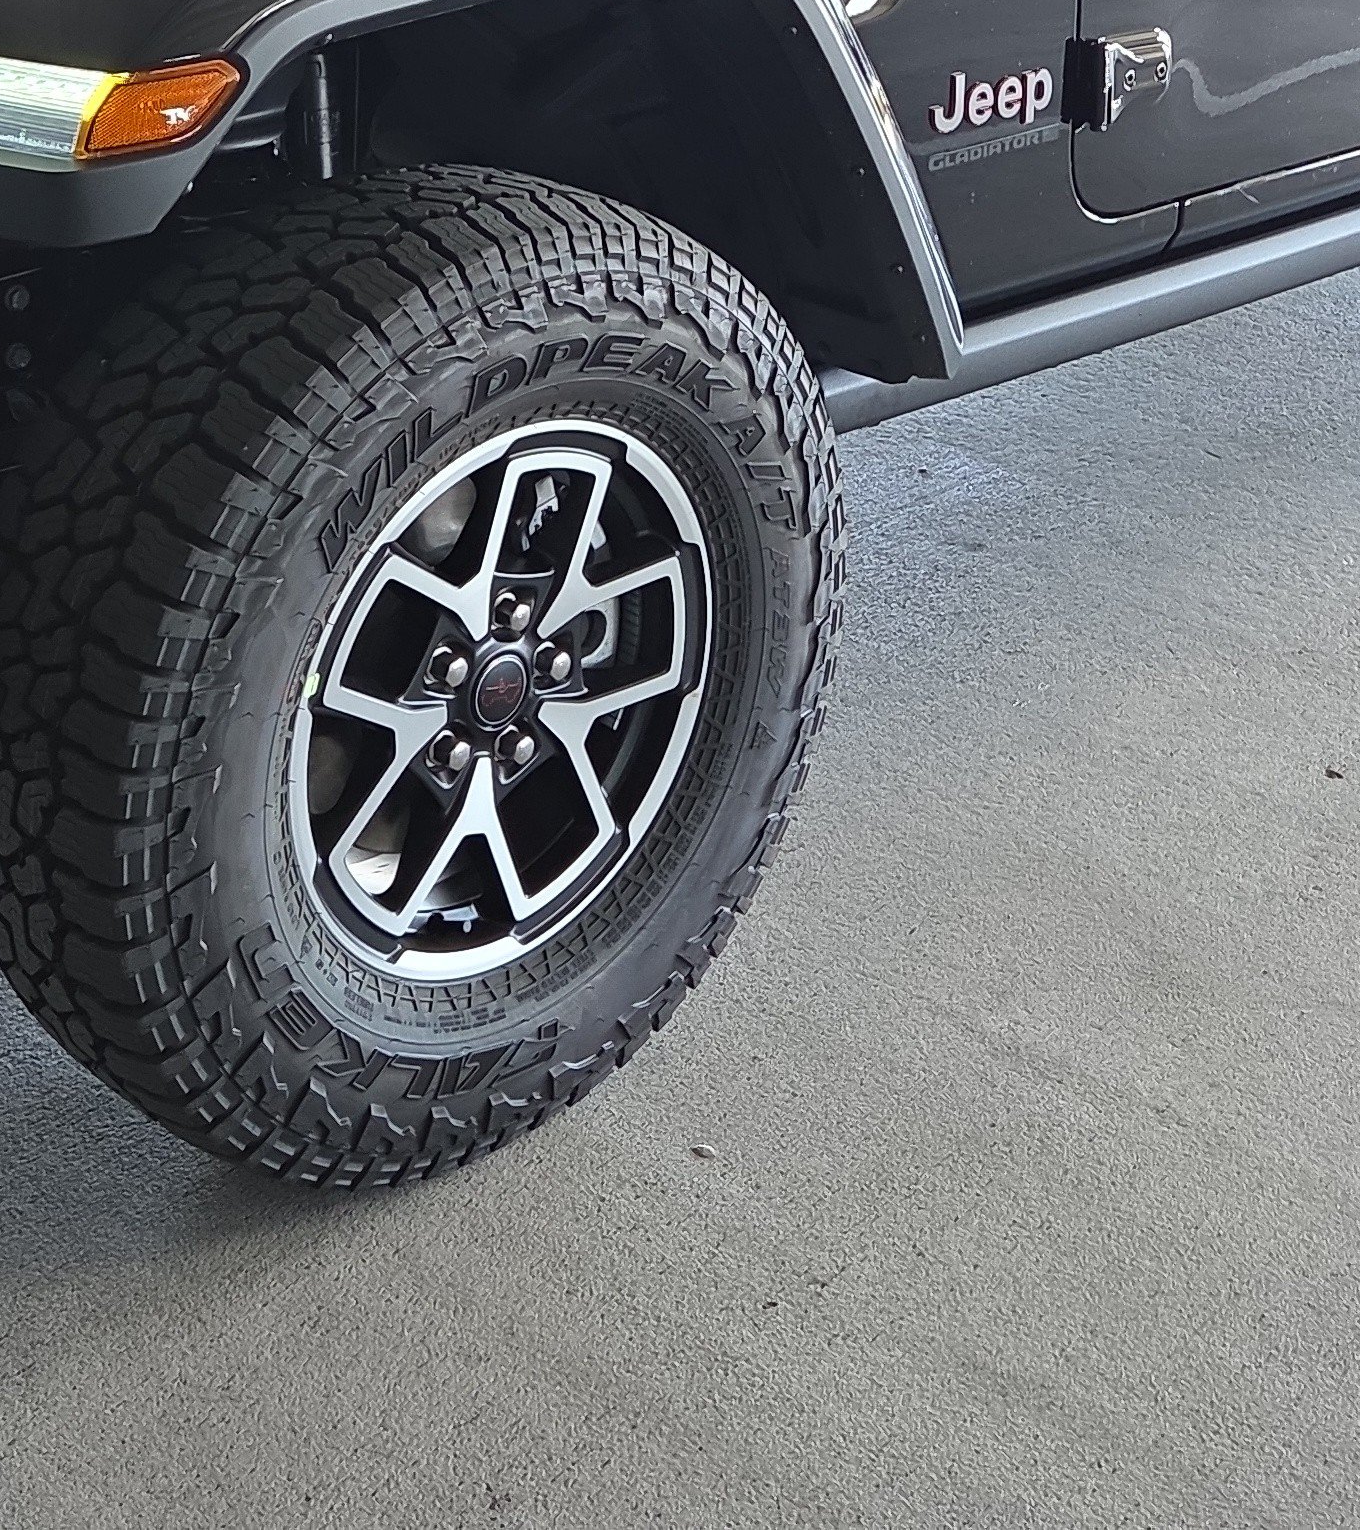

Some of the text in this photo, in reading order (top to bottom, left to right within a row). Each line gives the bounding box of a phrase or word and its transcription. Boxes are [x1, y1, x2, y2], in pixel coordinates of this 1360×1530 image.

[927, 66, 1054, 135] Jeep
[927, 130, 1040, 172] GLADIATOR
[320, 332, 739, 573] WILDPEAK
[237, 921, 565, 1100] FALKEN
